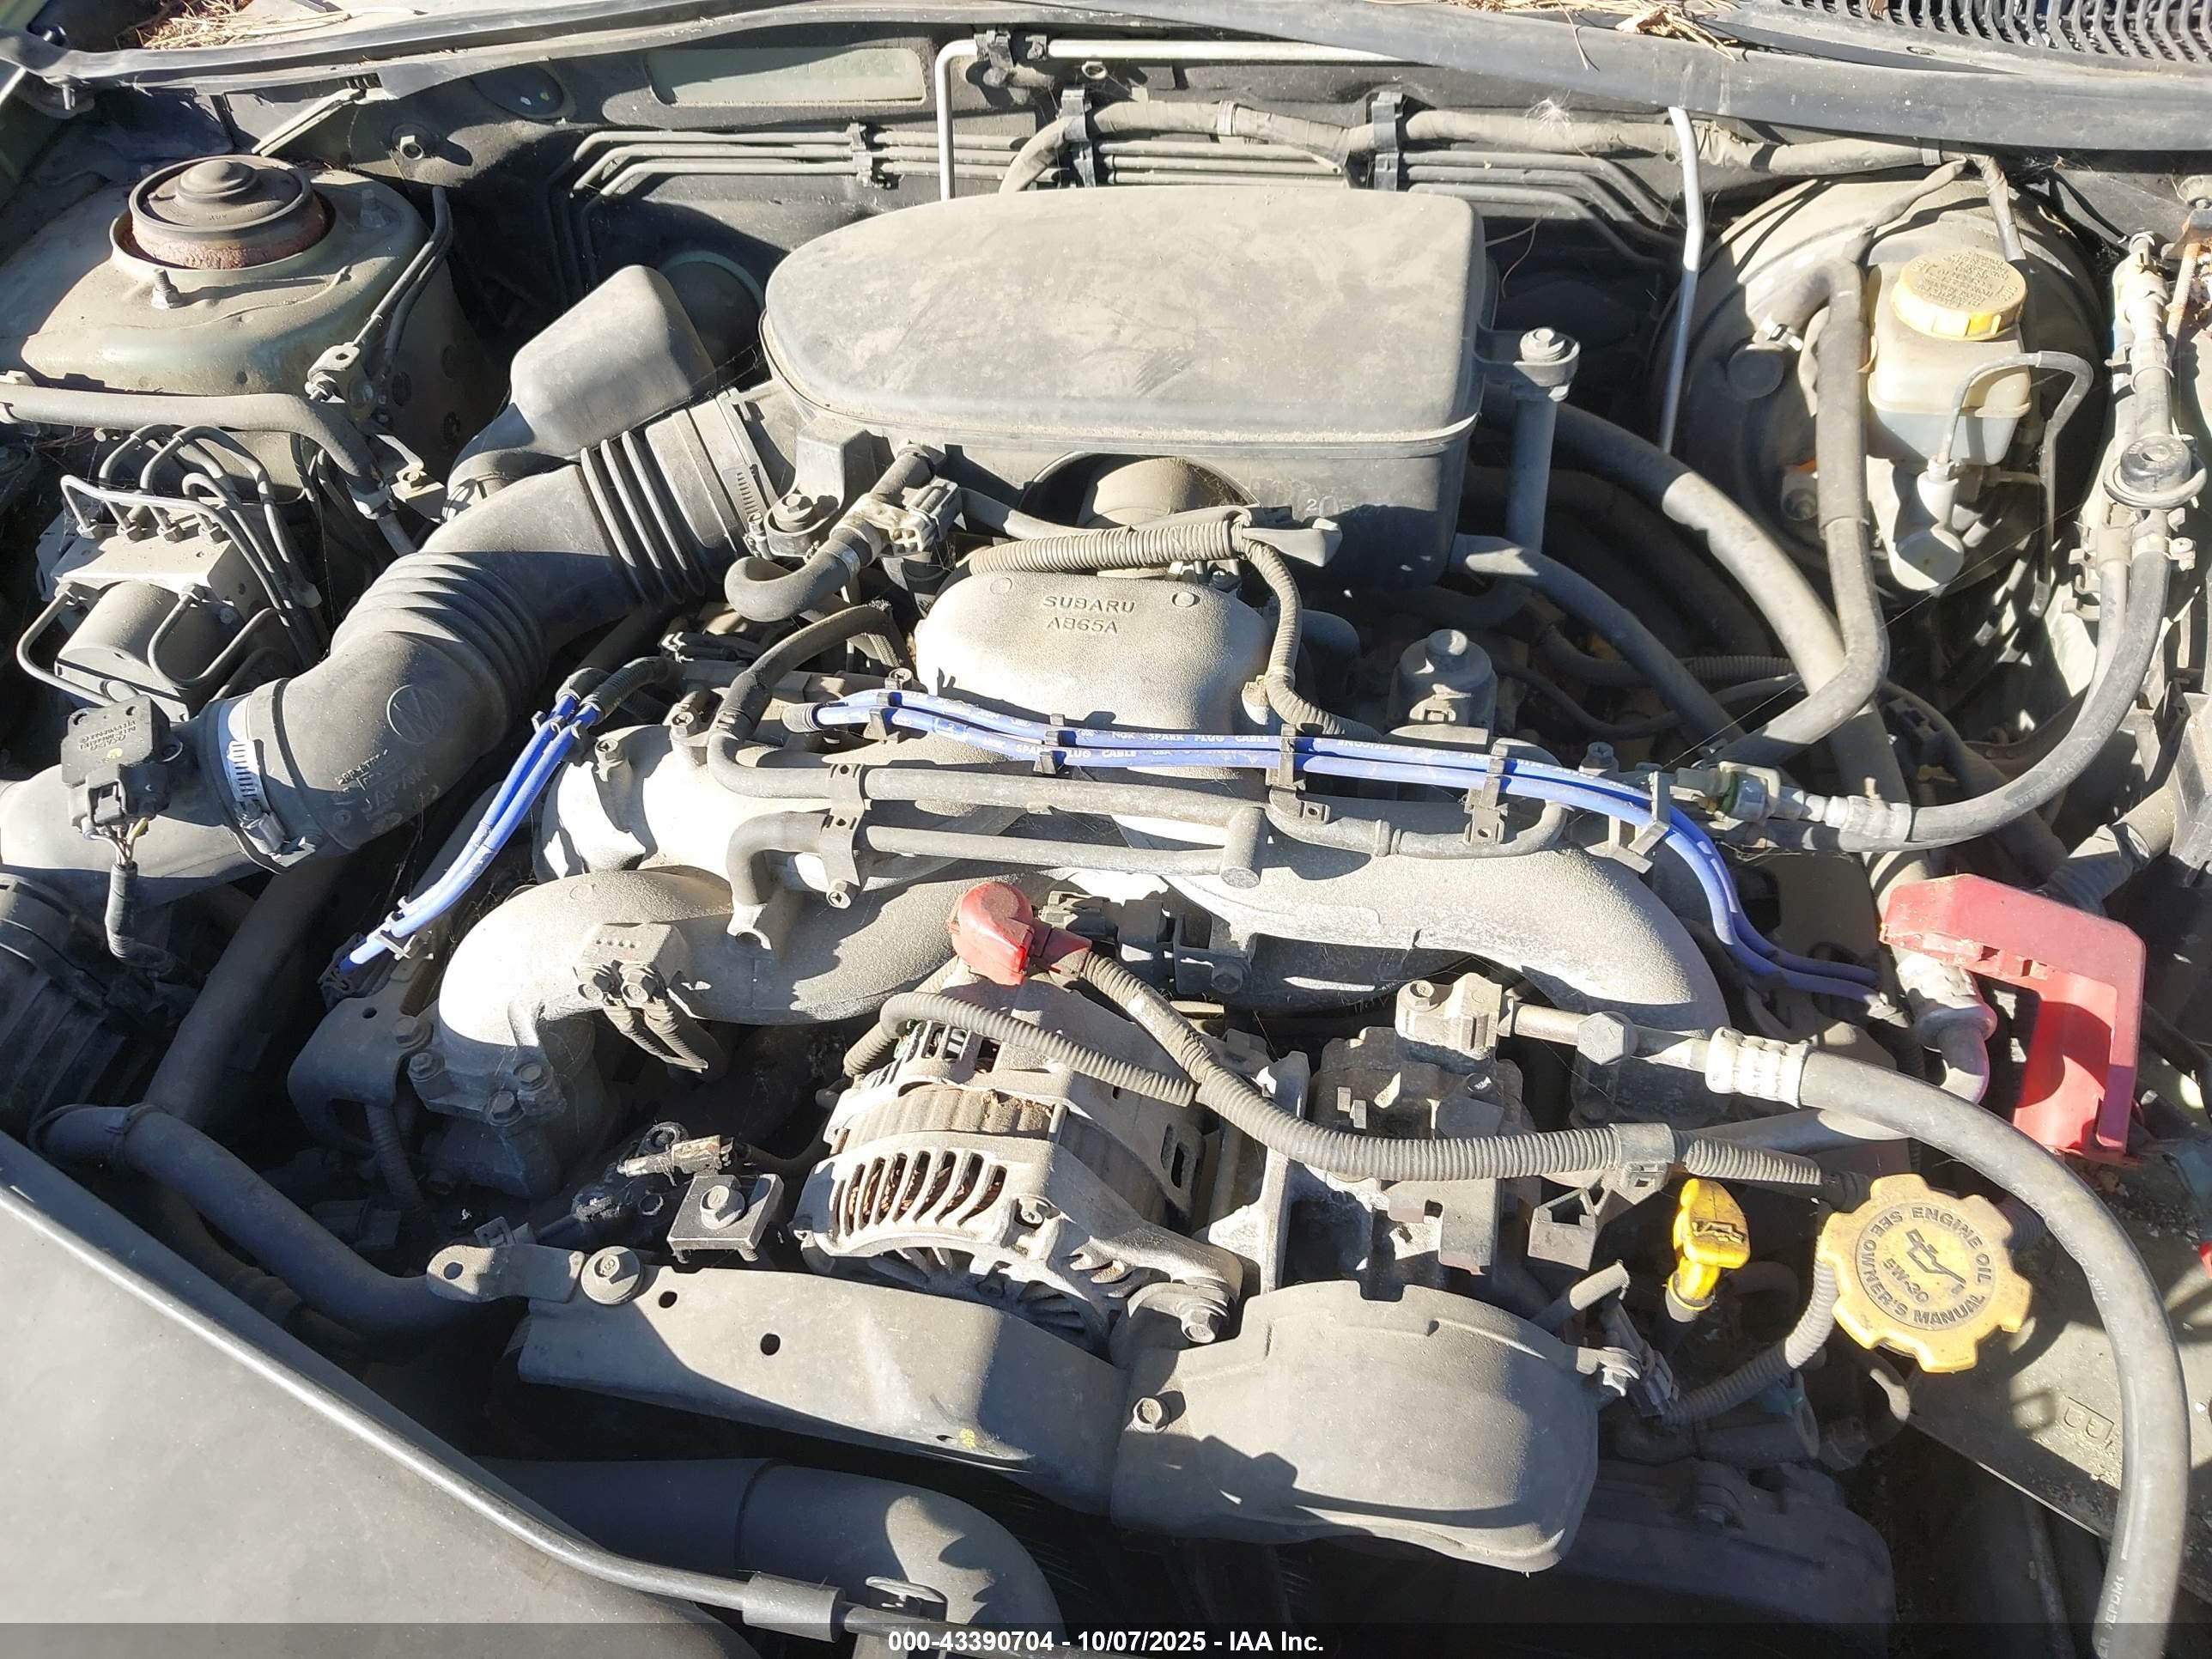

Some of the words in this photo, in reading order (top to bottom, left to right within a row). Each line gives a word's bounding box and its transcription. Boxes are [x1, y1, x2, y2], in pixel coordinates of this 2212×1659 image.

[1043, 596, 1135, 614] SUBARU
[1047, 617, 1118, 634] AB65A
[1147, 732, 1185, 742] SPARK
[1194, 734, 1225, 743] PLUG
[1235, 735, 1269, 744] CABLE
[1102, 749, 1137, 757] CABLE
[1869, 1210, 1904, 1238] SEE
[1911, 1206, 1984, 1249] ENGINE
[1976, 1253, 1992, 1284] OIL
[1861, 1239, 1909, 1316] OWNER'S
[1882, 1258, 1930, 1304] 5W-30
[1912, 1293, 1986, 1326] MANUAL
